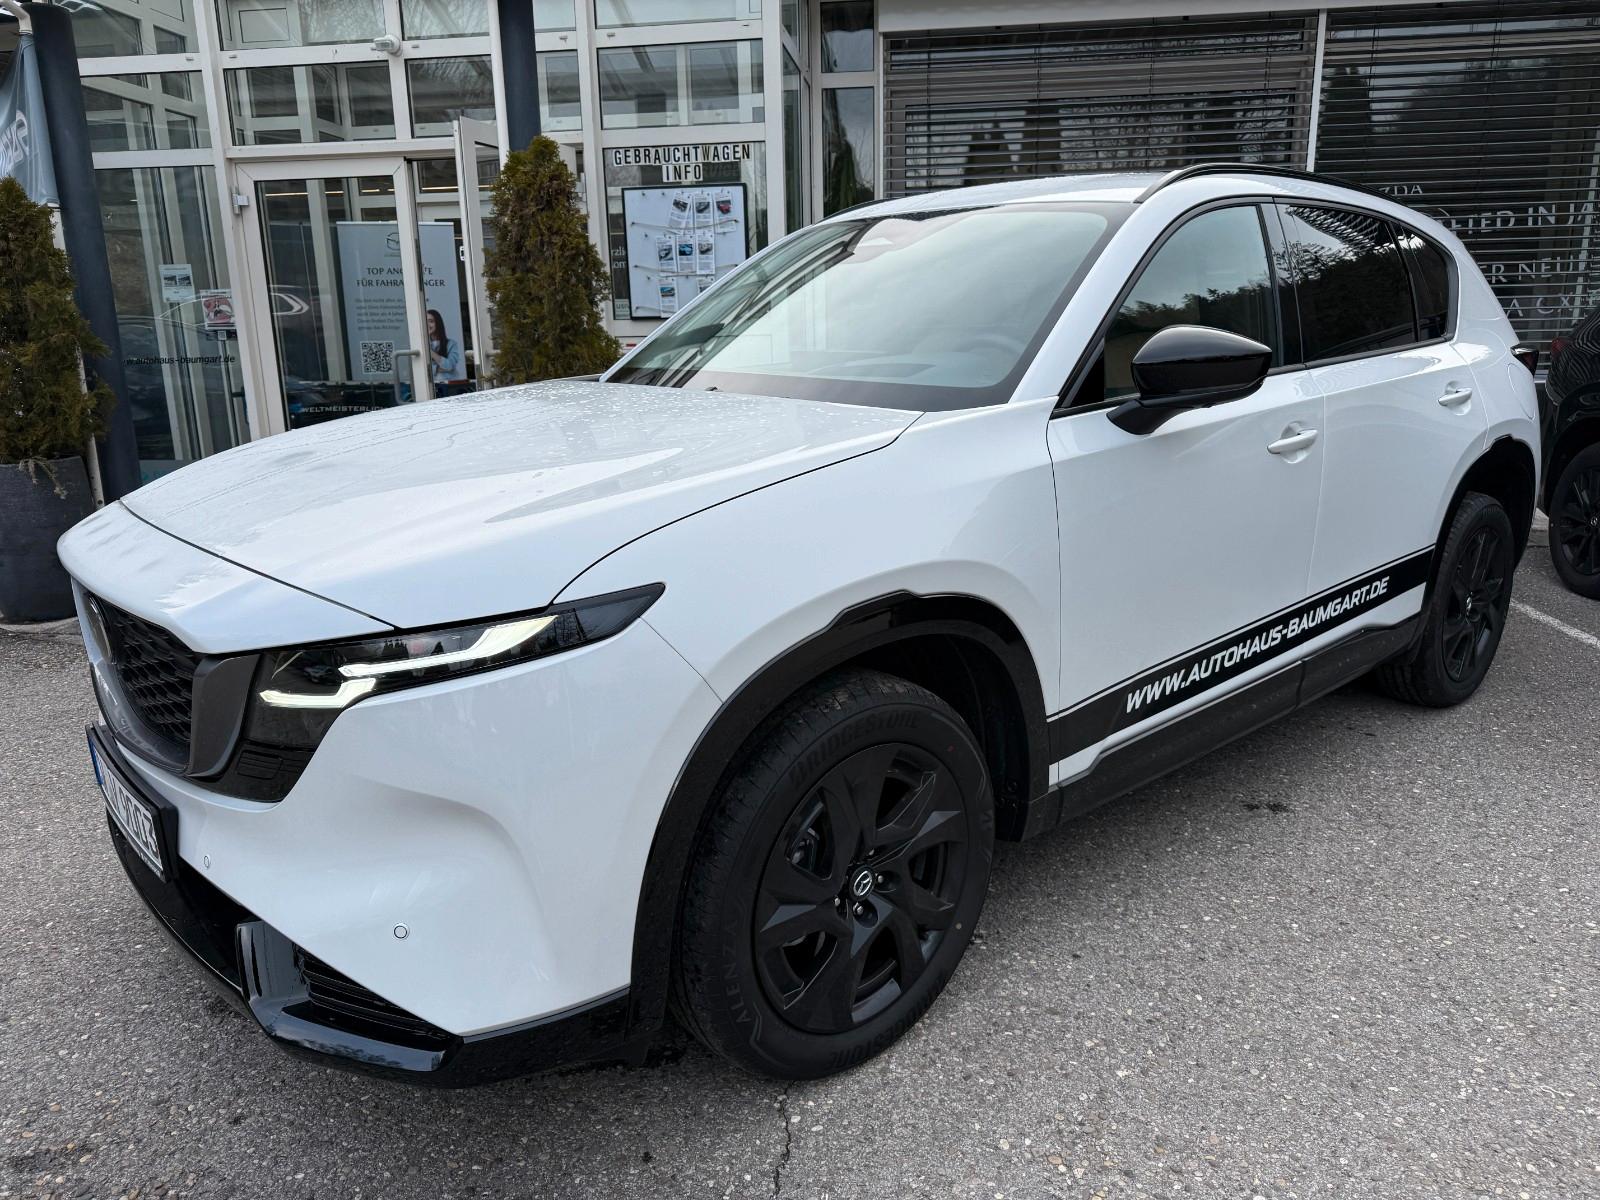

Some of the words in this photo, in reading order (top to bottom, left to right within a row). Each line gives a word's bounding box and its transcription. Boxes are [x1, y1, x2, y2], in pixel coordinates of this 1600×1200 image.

[614, 144, 750, 165] GEBRAUCHTWAGEN
[664, 164, 702, 181] INFO
[1527, 204, 1556, 227] IN
[367, 267, 385, 275] TOP
[357, 278, 374, 287] FÜR
[123, 355, 236, 366] w.autohaus-baumgart.de
[303, 405, 386, 413] WELTMEISTERLIC
[1126, 576, 1390, 713] WWW.AUTOHAUS-BAUMGART.DE
